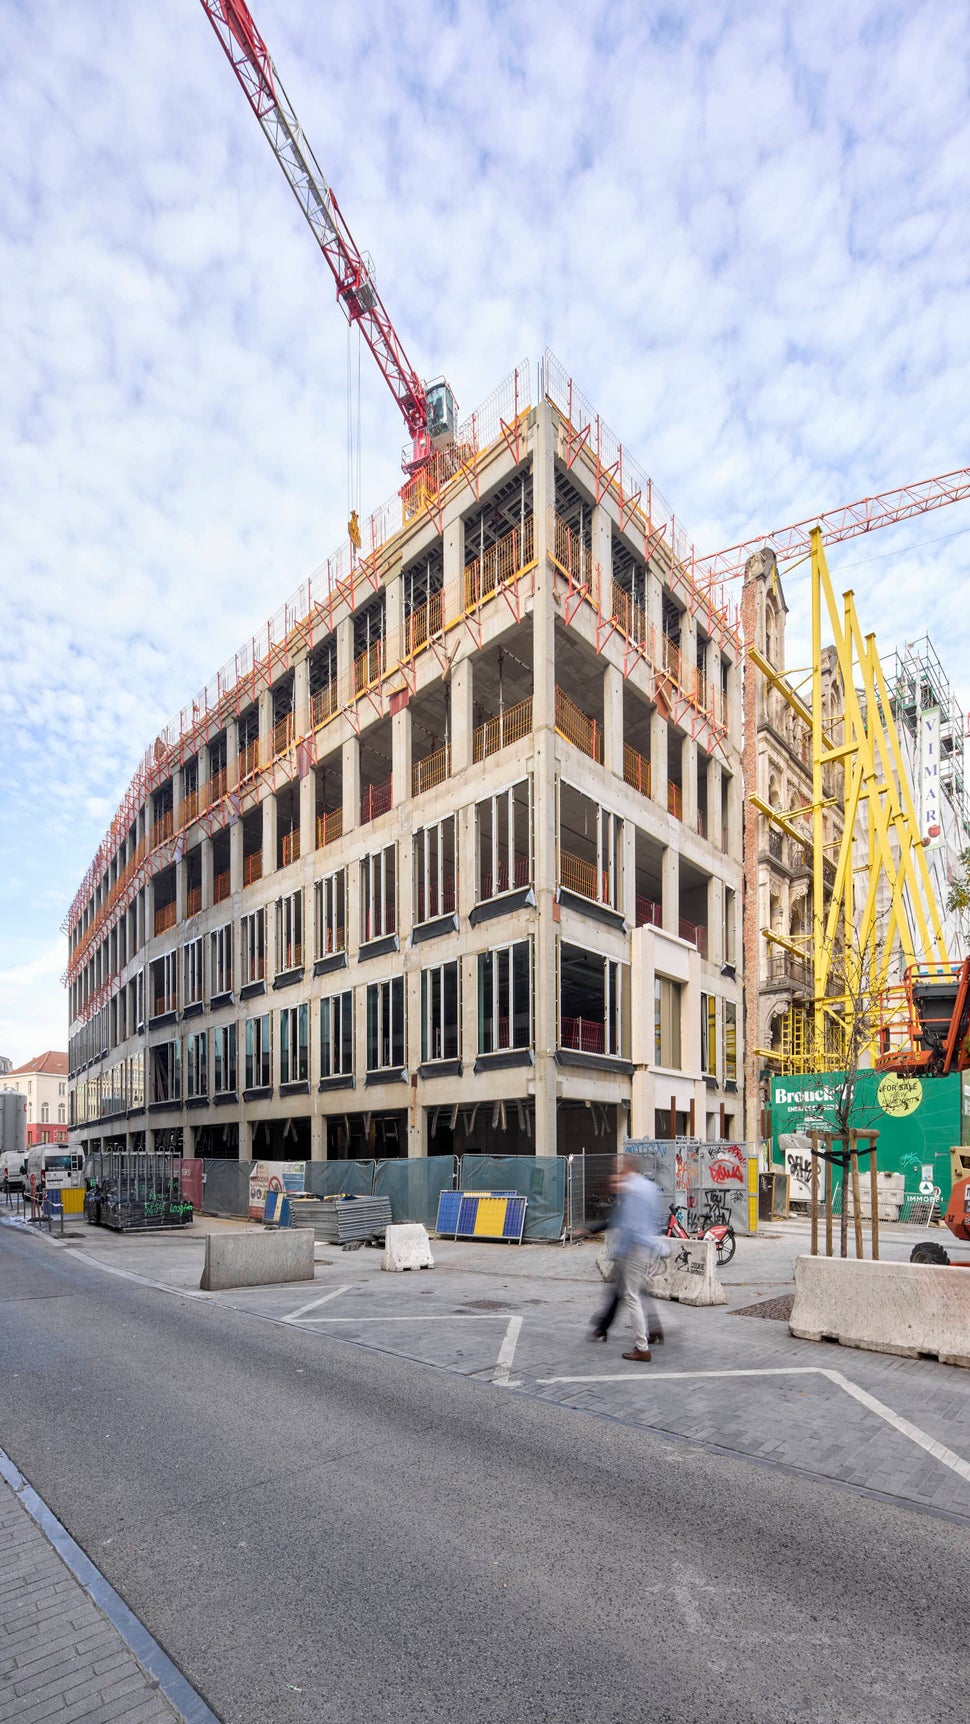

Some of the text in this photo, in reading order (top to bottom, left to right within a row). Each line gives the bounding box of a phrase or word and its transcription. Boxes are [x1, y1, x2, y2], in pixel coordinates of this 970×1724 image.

[924, 718, 938, 822] VIMAR
[882, 1083, 918, 1092] FOR SALE
